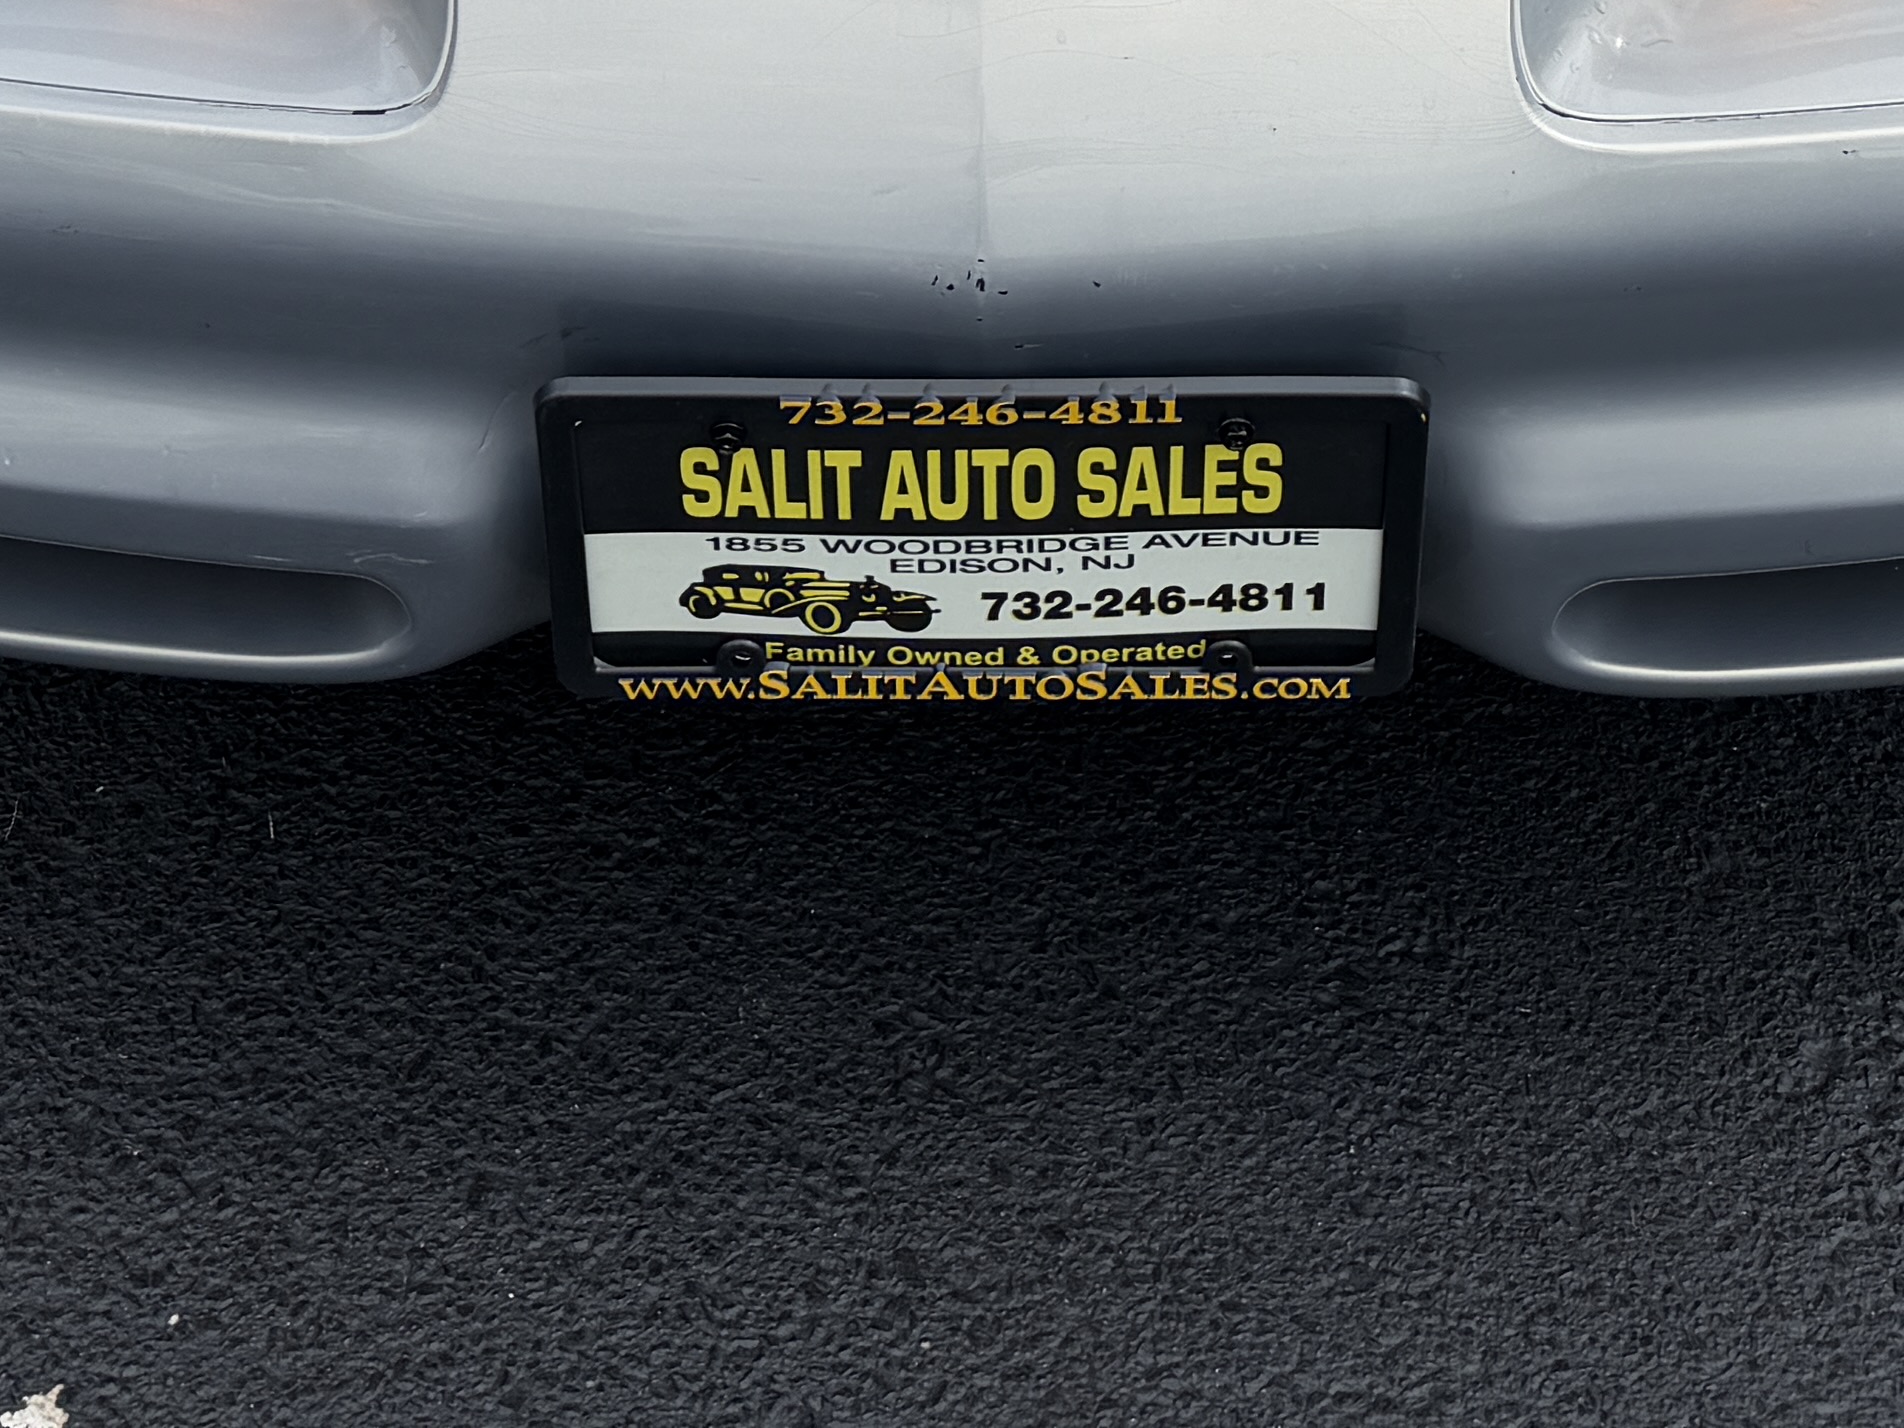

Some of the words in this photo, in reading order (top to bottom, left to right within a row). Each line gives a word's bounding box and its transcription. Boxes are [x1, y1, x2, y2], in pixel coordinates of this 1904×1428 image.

[779, 394, 1183, 426] 732-246-4811
[679, 446, 863, 520] SALIT
[880, 448, 1056, 521] AUTO
[1076, 442, 1284, 519] SALES
[705, 536, 807, 553] 1855
[818, 535, 1130, 556] WOODBRIDGE
[1141, 530, 1321, 550] AVENUE
[890, 556, 1065, 575] EDISON,
[1081, 554, 1136, 571] NJ
[981, 582, 1327, 622] 732-246-4811
[765, 640, 876, 667] Family
[886, 646, 1004, 666] Owned
[1016, 646, 1041, 666] &
[1052, 638, 1207, 665] Operated
